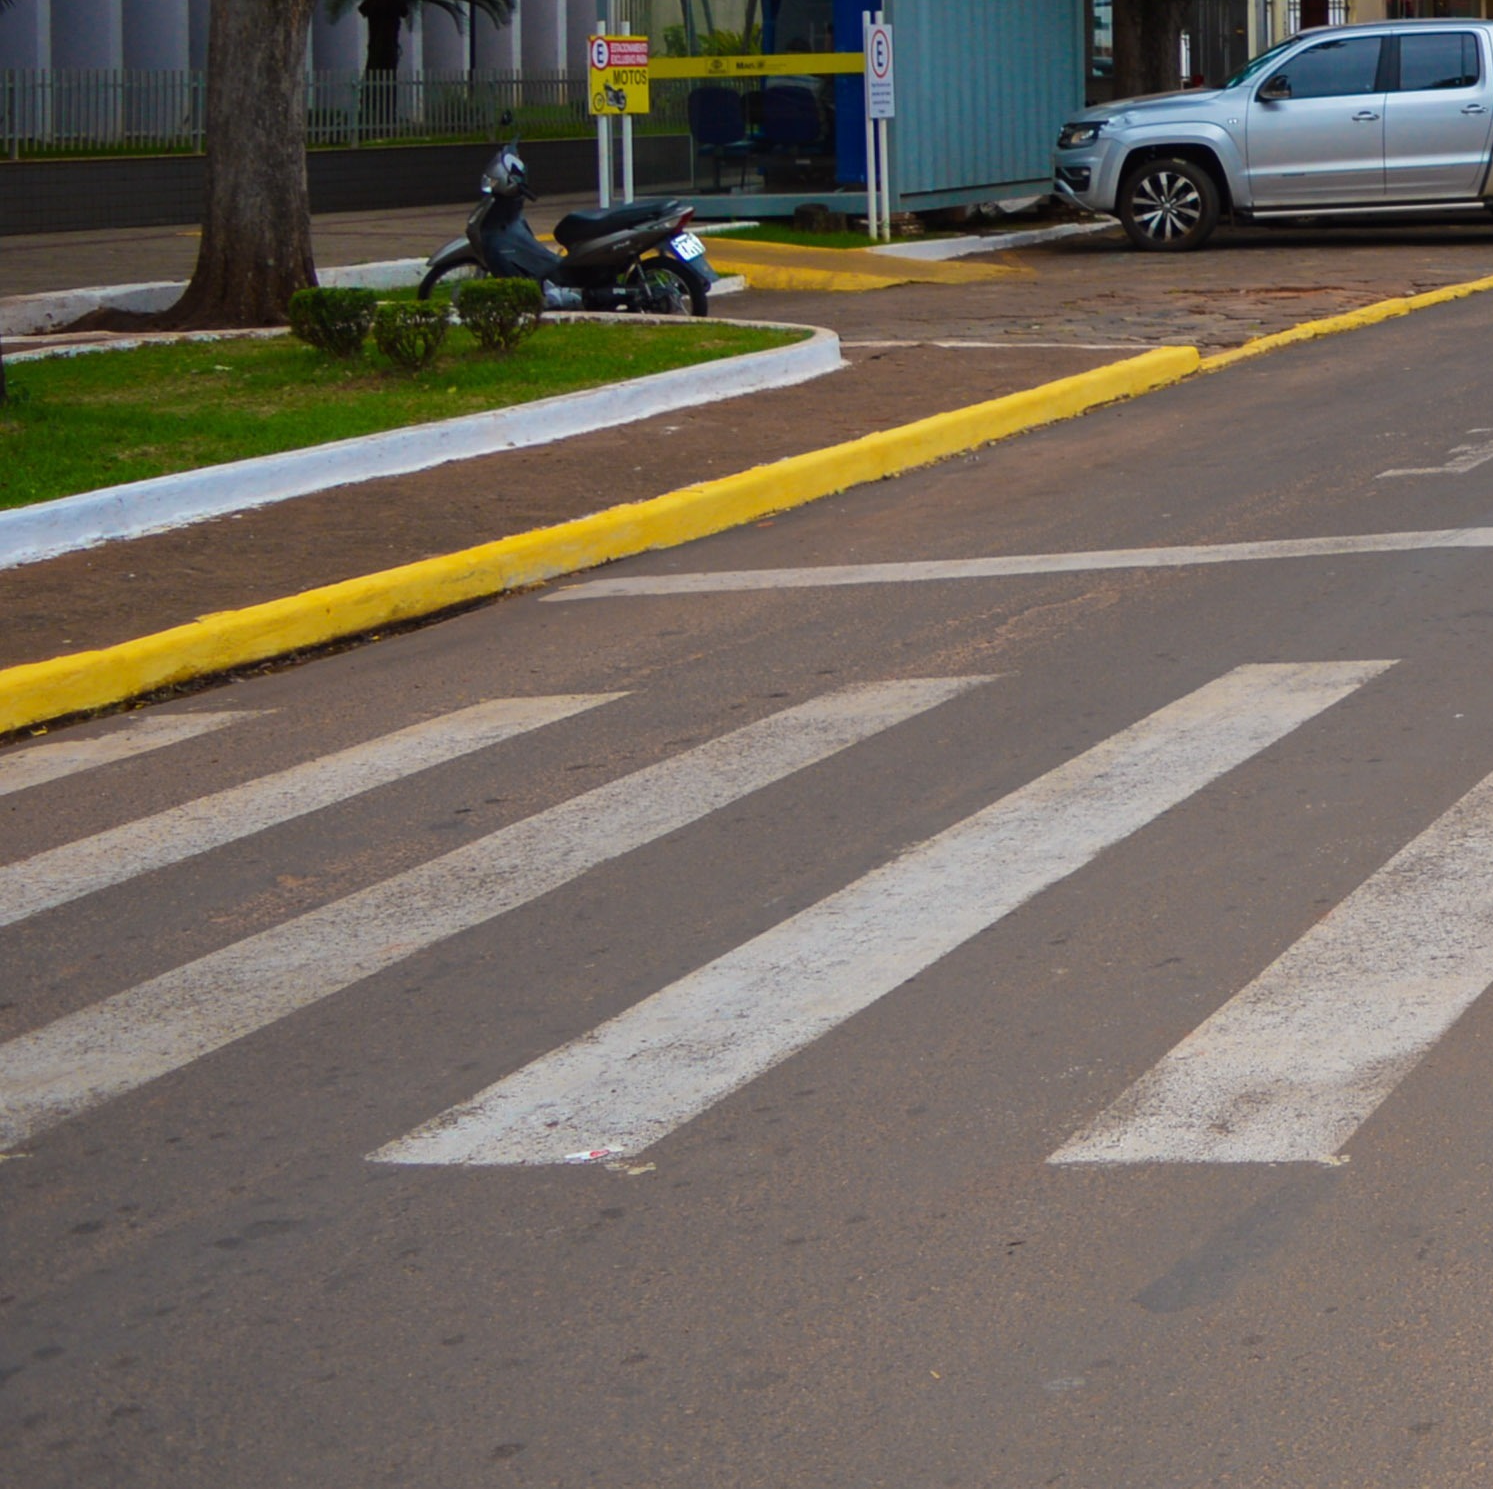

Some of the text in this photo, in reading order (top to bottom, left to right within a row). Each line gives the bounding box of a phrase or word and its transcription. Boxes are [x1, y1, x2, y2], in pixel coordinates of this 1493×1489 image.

[597, 43, 604, 64] E
[877, 40, 883, 67] E
[613, 69, 647, 85] MOTOS
